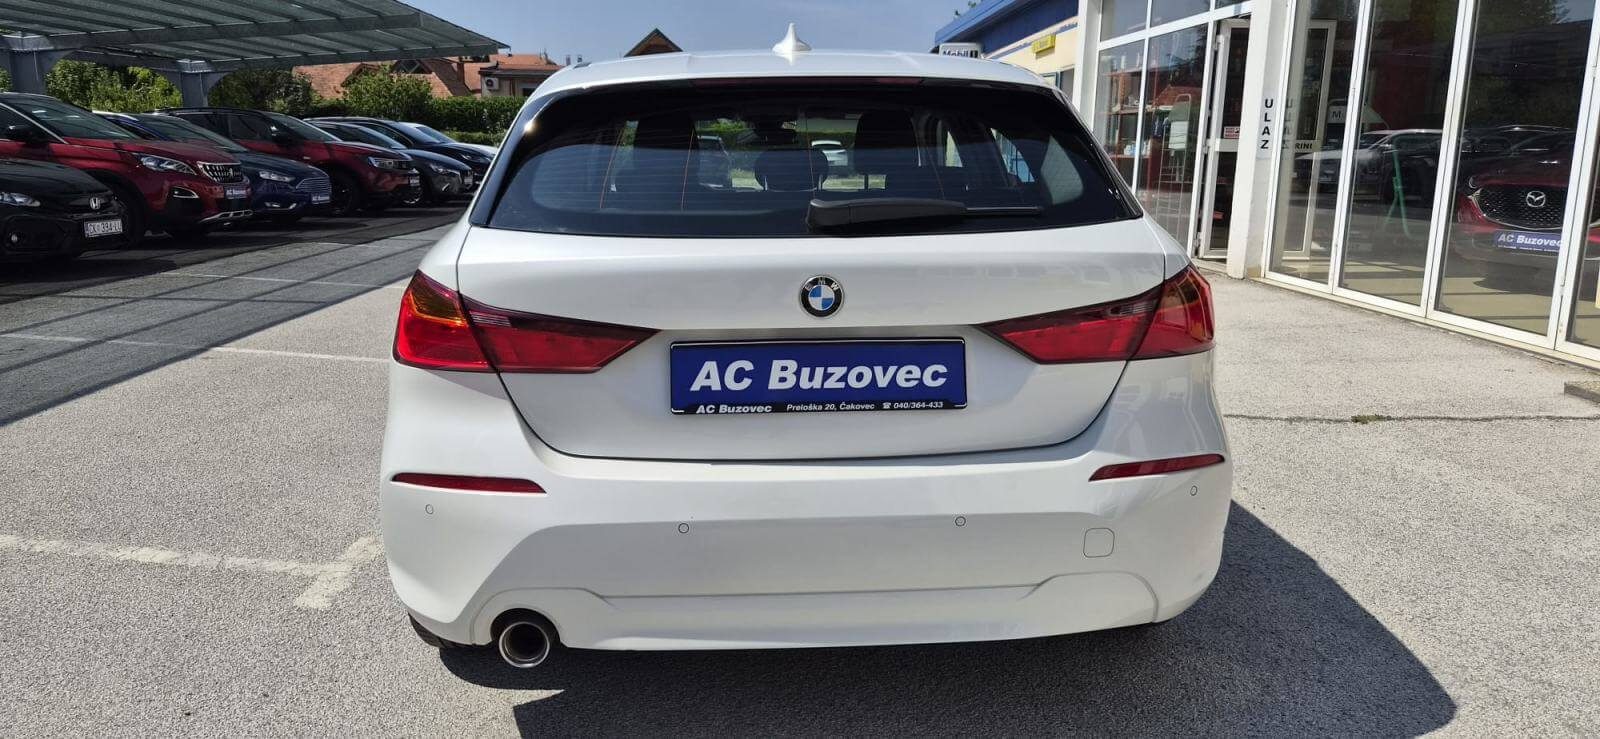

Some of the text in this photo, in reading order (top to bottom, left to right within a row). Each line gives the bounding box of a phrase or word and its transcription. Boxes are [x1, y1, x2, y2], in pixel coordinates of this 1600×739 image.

[1260, 98, 1274, 150] ULAZ
[1497, 233, 1514, 243] AC
[804, 276, 840, 291] BMW
[690, 359, 948, 391] AC Buzovec
[696, 401, 943, 414] AC Buzovec Preloška 20, Čakovec 040/364-433
